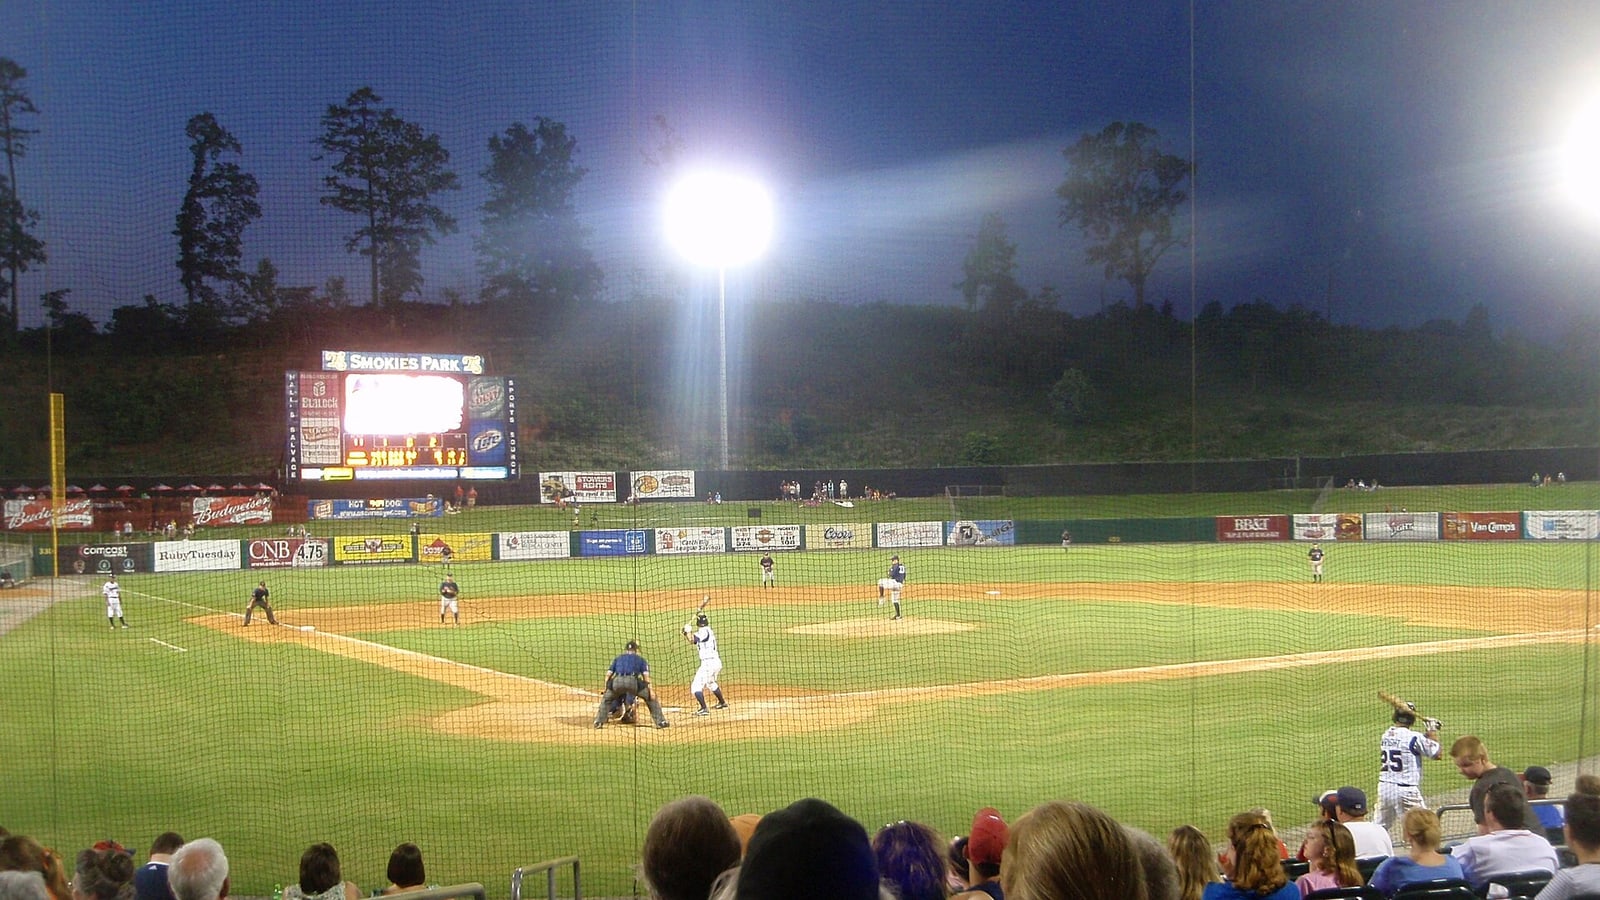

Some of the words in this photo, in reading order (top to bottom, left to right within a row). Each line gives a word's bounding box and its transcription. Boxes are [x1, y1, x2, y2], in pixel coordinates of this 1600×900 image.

[350, 354, 419, 370] SMOKIES
[421, 356, 460, 371] PARK
[289, 427, 297, 478] SALVAGE
[196, 496, 271, 524] Budweiser
[348, 500, 364, 508] HOT
[8, 499, 91, 529] Budwiser
[1234, 518, 1270, 531] BB&T
[1470, 522, 1487, 533] Van
[1488, 521, 1516, 533] Camp's
[824, 527, 853, 539] Coors
[83, 546, 128, 555] comcast
[249, 540, 290, 559] CNB
[297, 544, 323, 559] 4.75
[1380, 750, 1403, 772] 25
